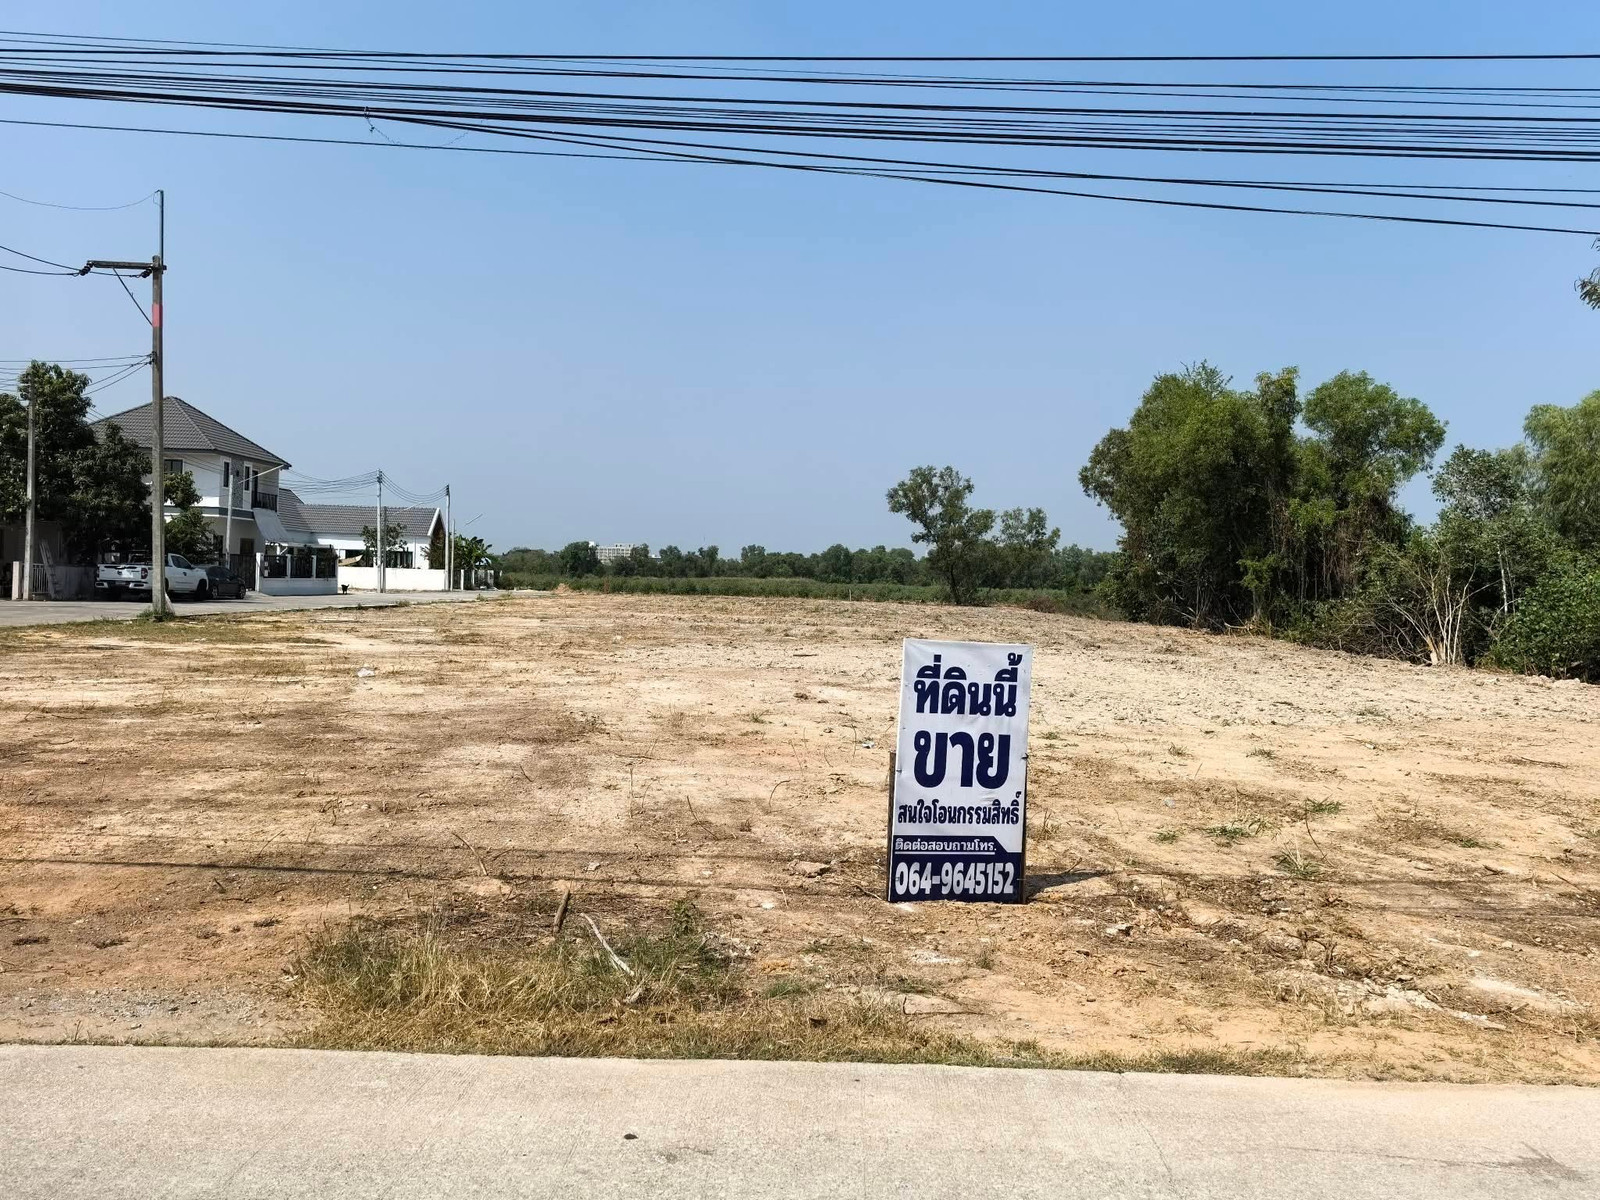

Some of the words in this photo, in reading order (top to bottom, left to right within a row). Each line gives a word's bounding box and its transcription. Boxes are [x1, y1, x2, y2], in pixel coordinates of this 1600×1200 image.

[914, 653, 1022, 717] ที่ดินนี้
[914, 730, 1011, 789] ขาย
[897, 791, 1022, 825] สนใจโอนกรรมสิทธิ์
[895, 861, 1015, 895] 064-9645152
